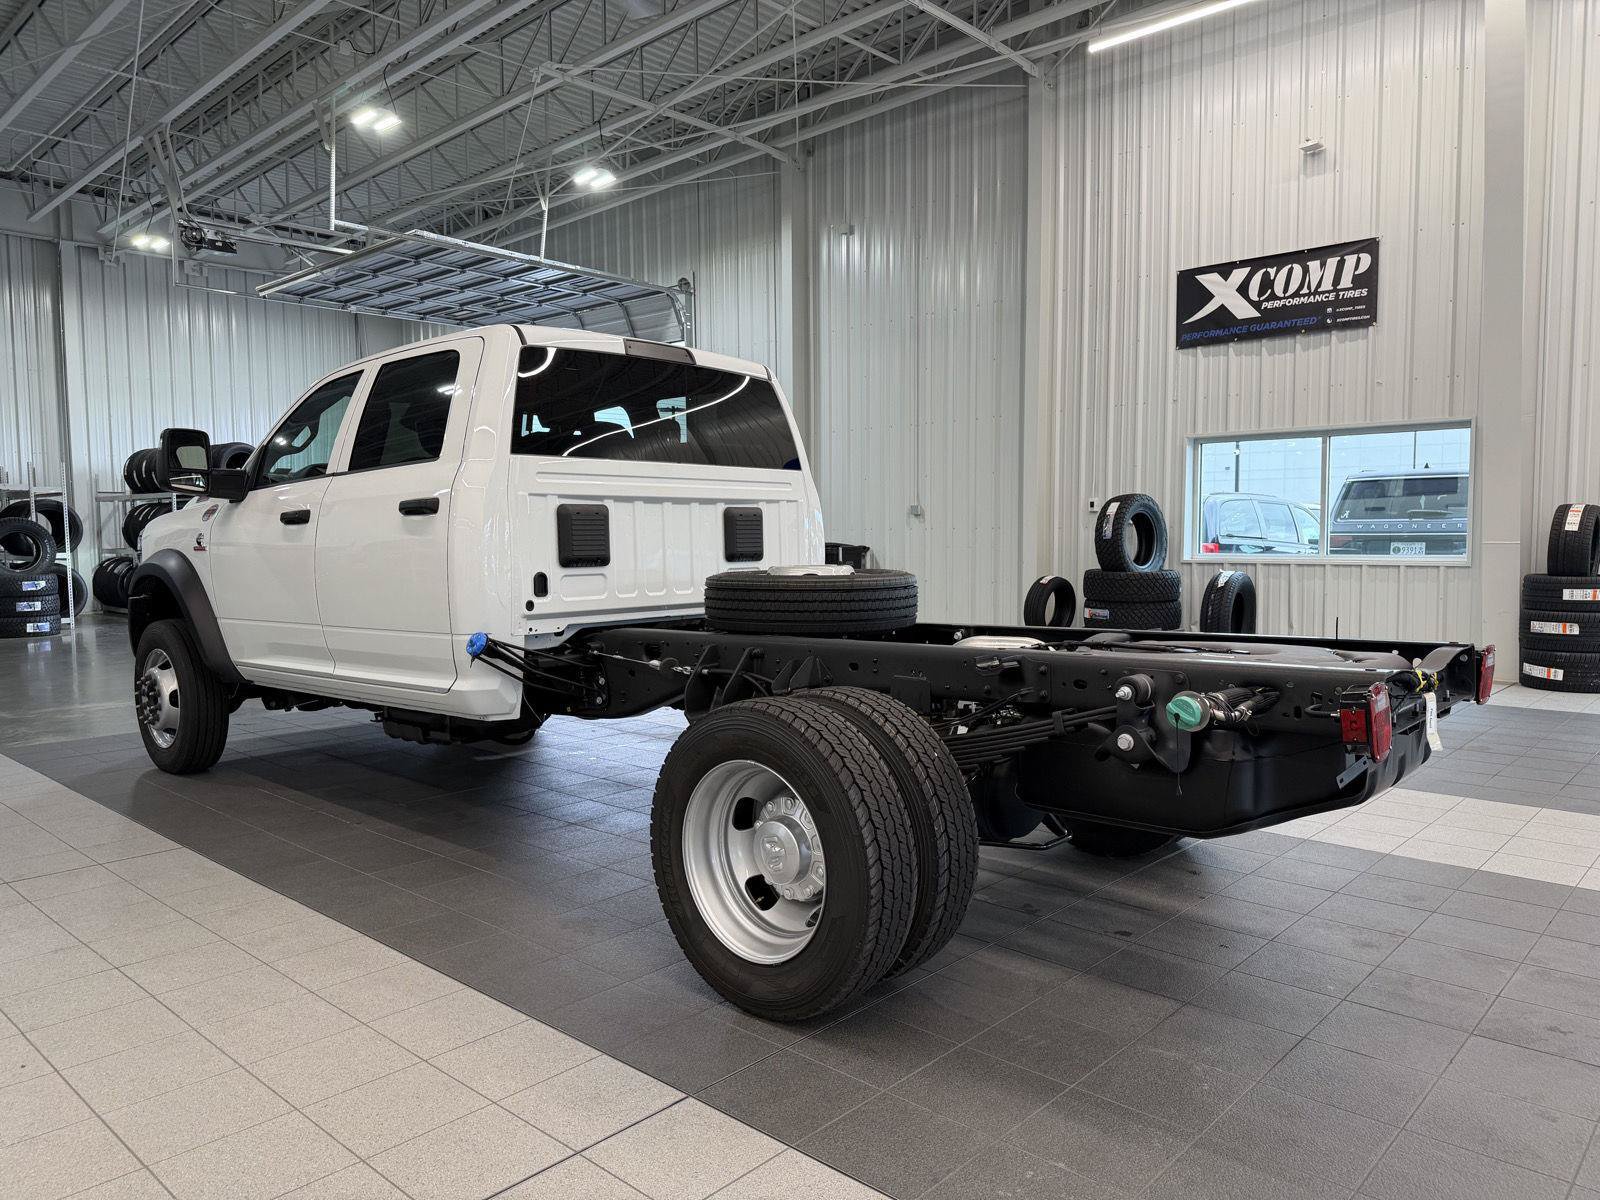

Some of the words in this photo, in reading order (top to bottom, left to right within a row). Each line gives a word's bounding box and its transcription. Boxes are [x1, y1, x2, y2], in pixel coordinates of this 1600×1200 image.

[1261, 292, 1336, 309] PERFORMANCE
[1338, 288, 1368, 300] TIRES
[1181, 325, 1249, 341] PERFORMANCE
